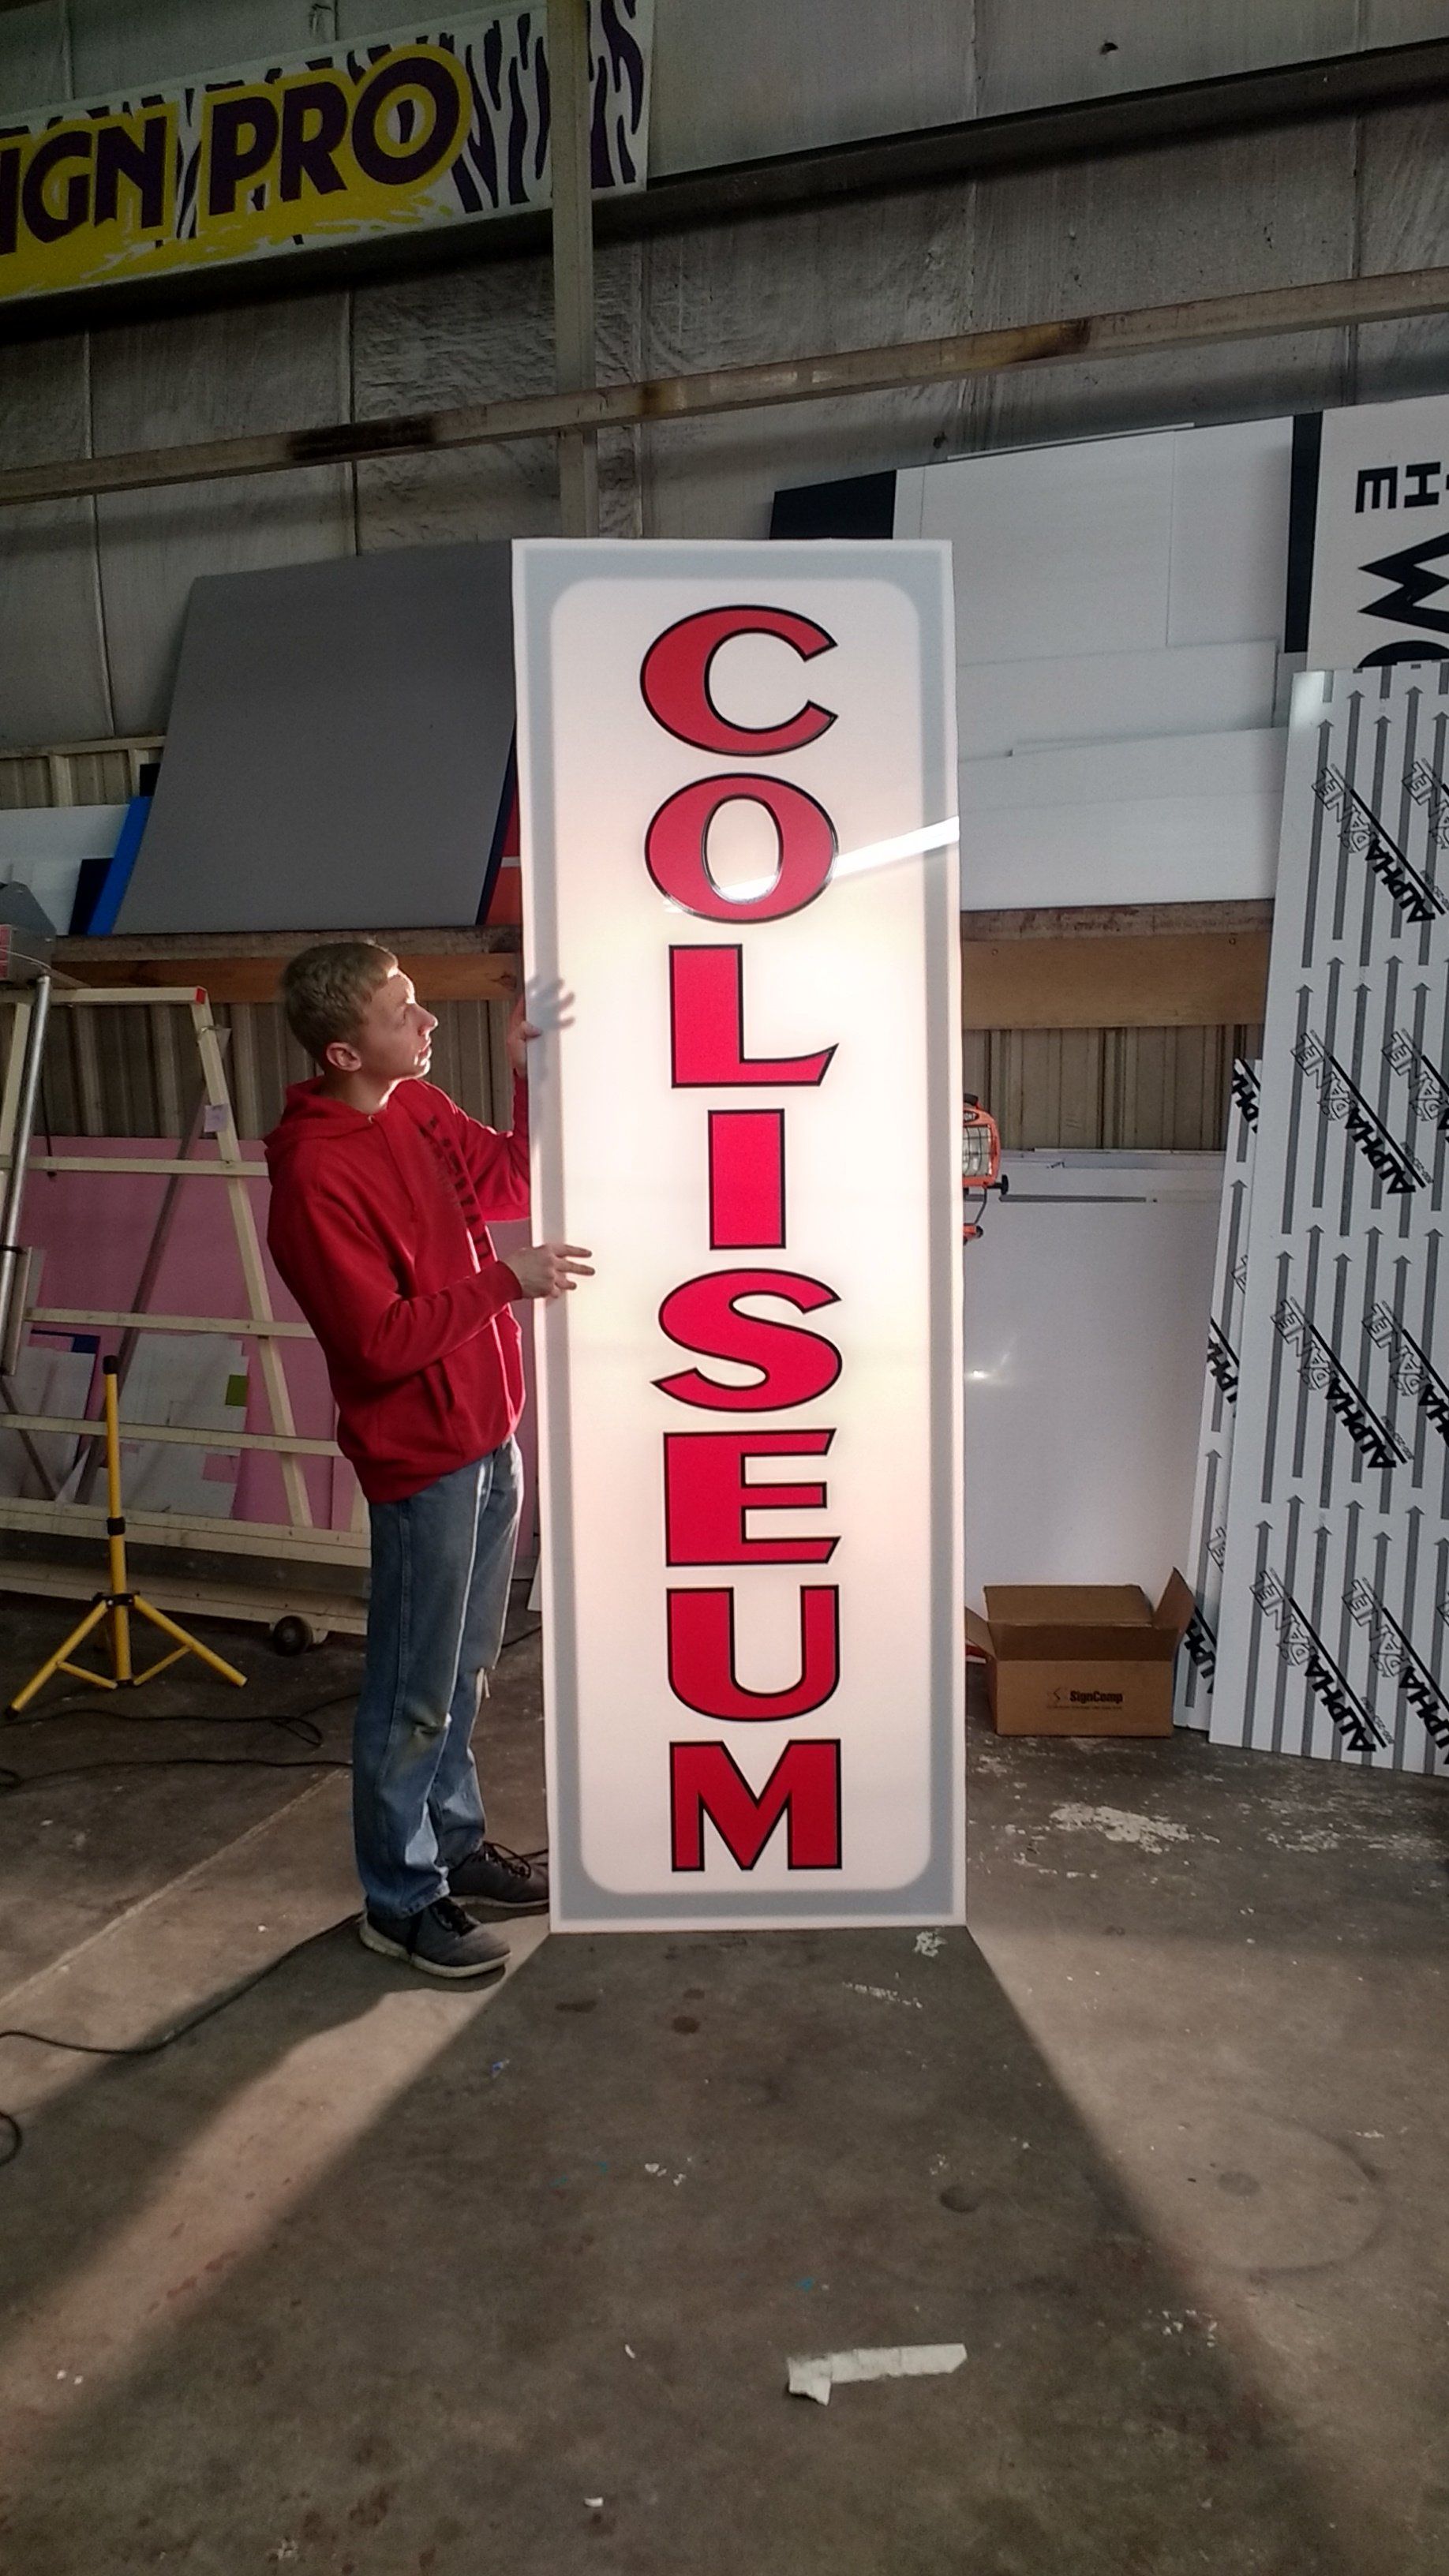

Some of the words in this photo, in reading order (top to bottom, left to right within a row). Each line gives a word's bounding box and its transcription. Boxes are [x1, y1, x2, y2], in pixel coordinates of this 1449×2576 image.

[208, 56, 462, 217] PRO
[1355, 462, 1449, 513] HE
[640, 605, 842, 1871] COLISEUM
